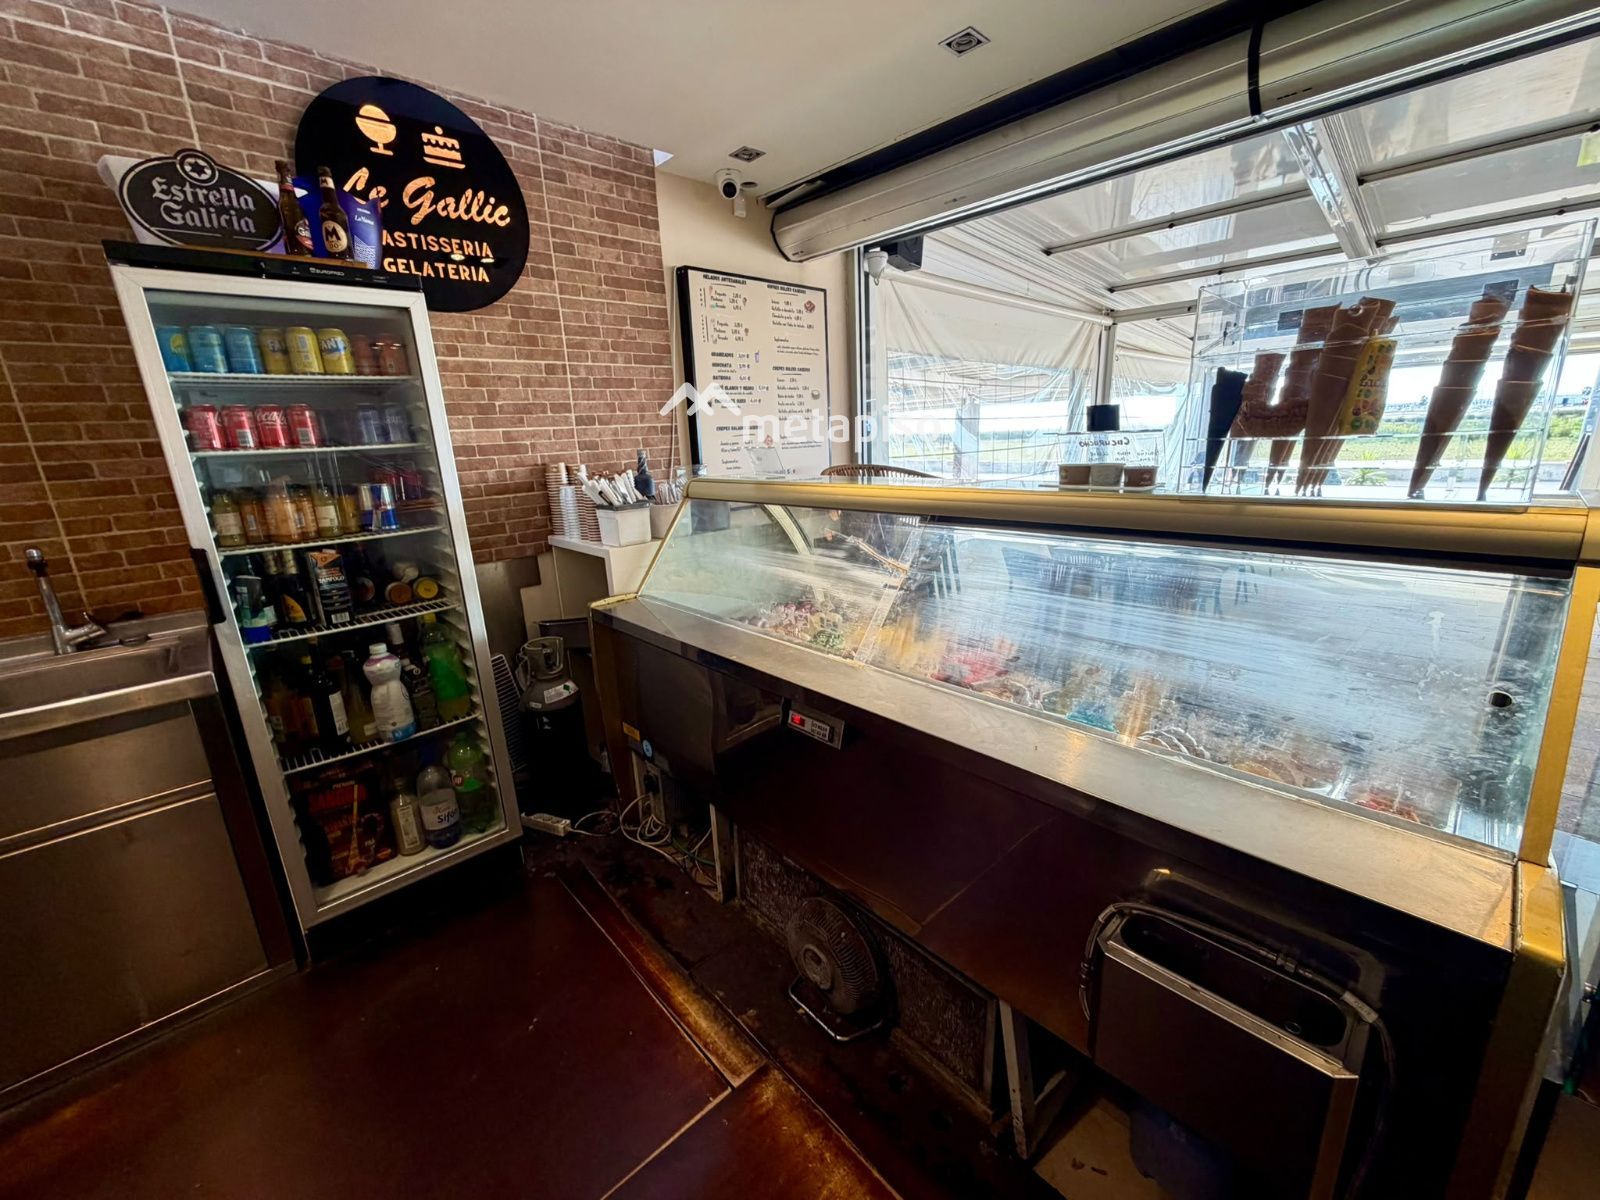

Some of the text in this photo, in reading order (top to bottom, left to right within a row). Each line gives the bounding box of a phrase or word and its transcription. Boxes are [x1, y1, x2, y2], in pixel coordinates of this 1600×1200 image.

[151, 176, 256, 212] Estrella
[402, 176, 511, 227] Gallic
[160, 201, 256, 233] Galicia
[382, 229, 493, 258] ASTISSERIA
[383, 257, 490, 283] GELATERIA
